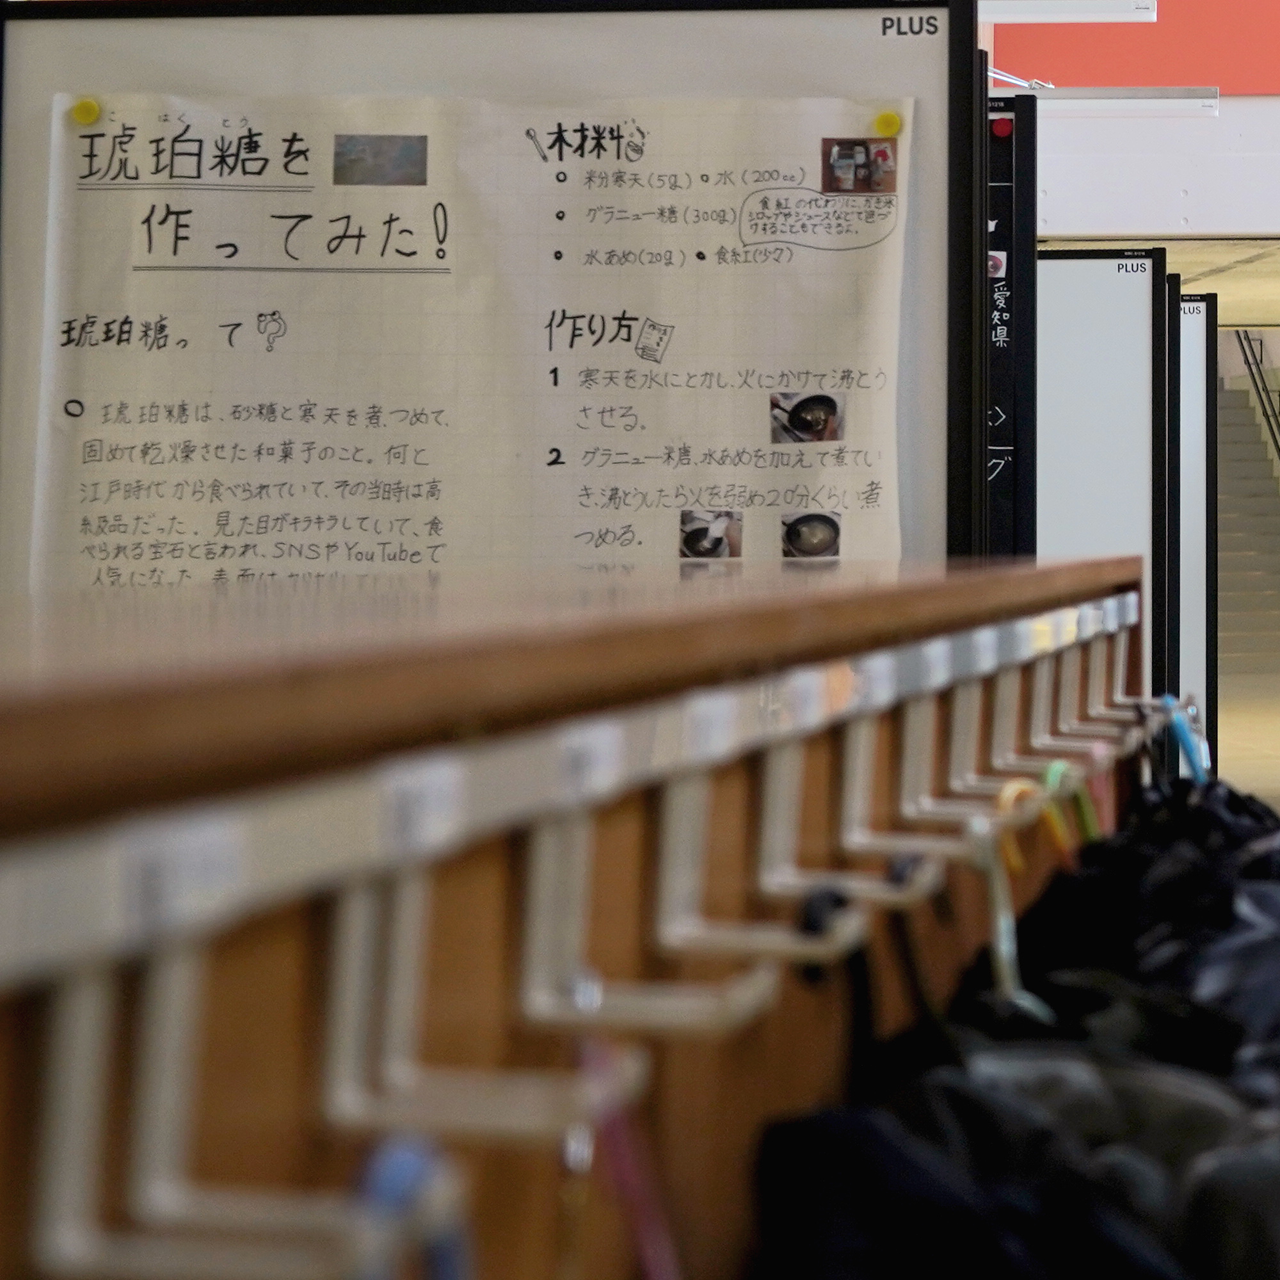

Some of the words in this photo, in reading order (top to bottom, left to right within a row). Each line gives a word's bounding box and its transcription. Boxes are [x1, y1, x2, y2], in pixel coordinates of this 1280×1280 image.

[881, 15, 939, 36] PLUS
[1117, 262, 1147, 274] PLUS
[991, 280, 1011, 348] 愛知県
[544, 309, 640, 352] 作り方
[550, 366, 559, 387] 1
[546, 448, 566, 466] 2
